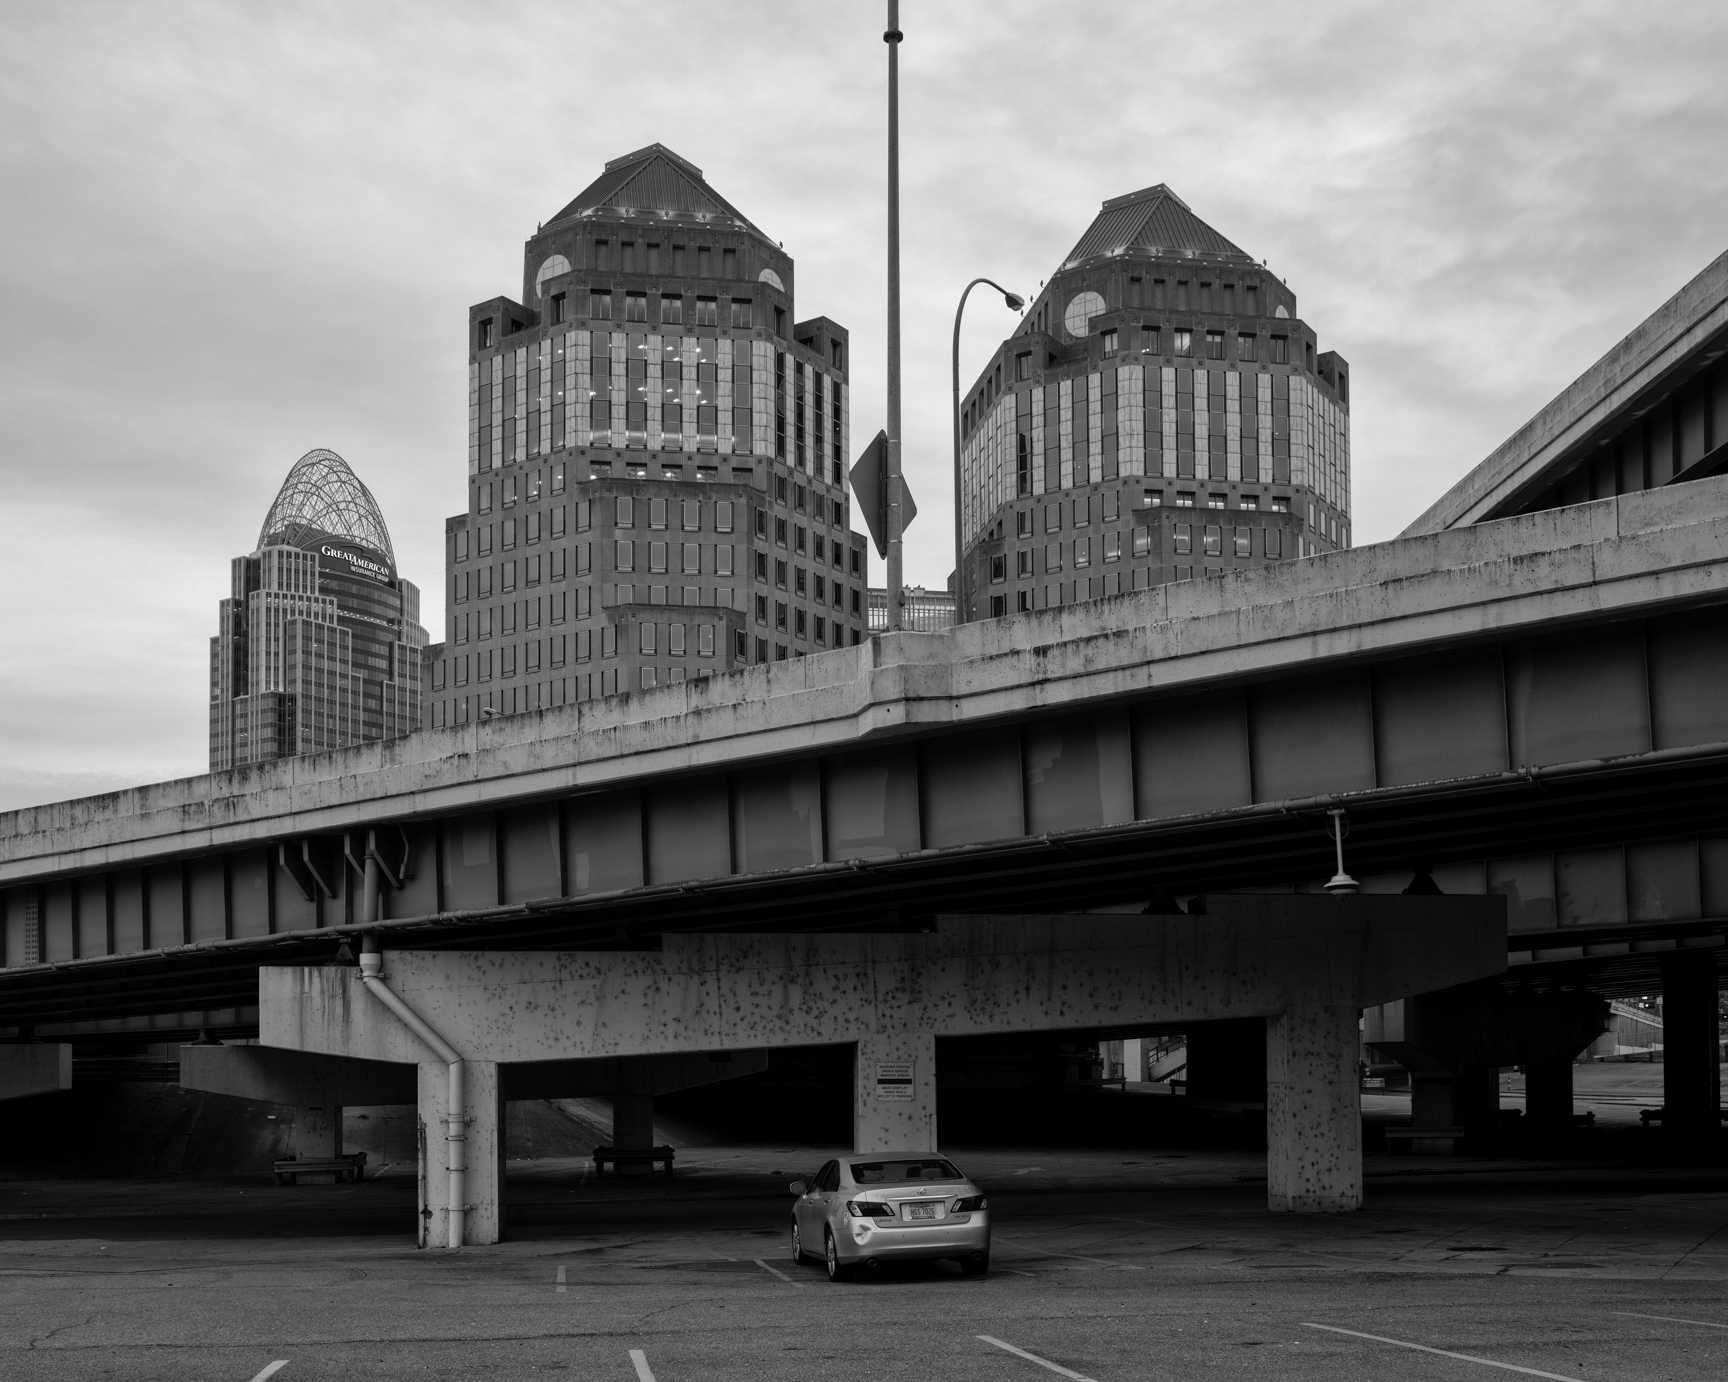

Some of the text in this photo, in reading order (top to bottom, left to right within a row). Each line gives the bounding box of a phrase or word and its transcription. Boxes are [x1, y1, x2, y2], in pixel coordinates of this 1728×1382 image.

[321, 545, 389, 575] GREAT AMERICAN
[350, 565, 375, 578] INSURANCE
